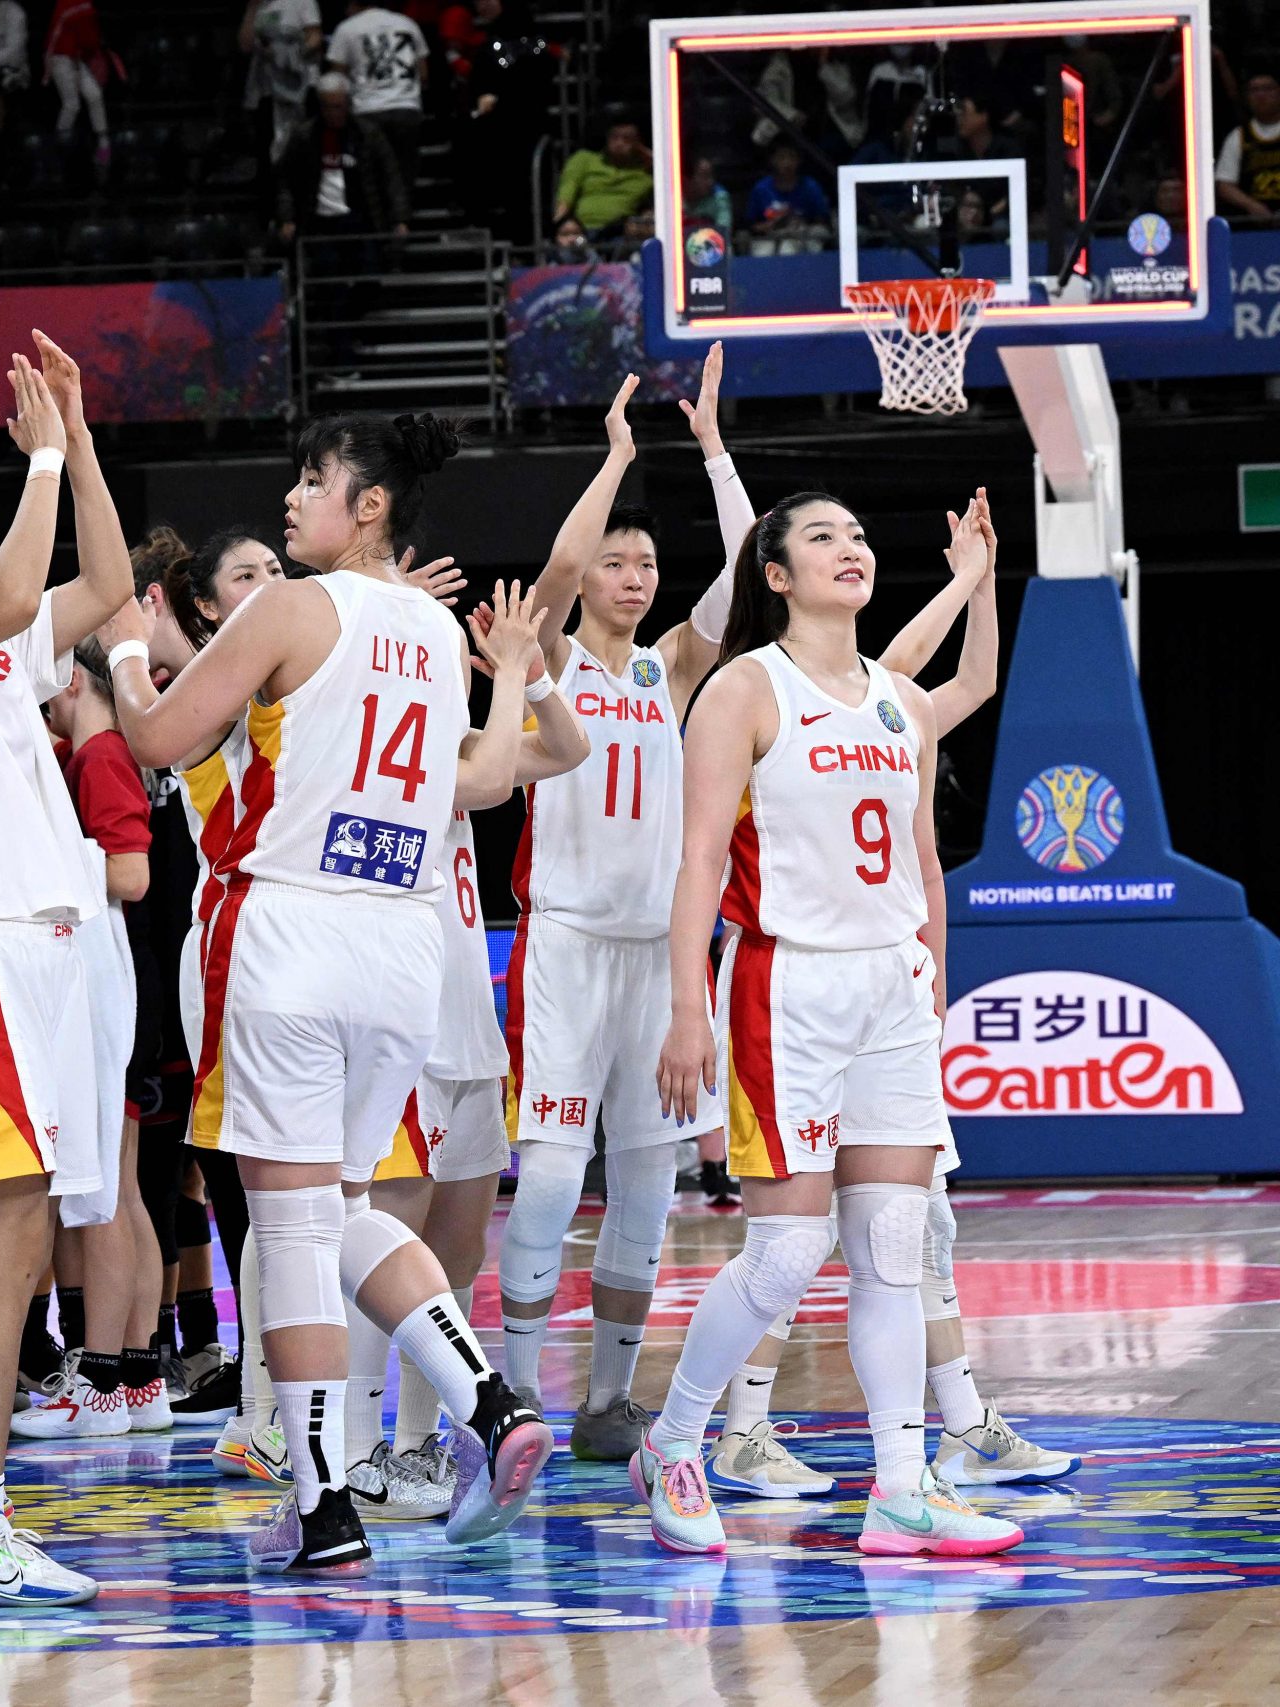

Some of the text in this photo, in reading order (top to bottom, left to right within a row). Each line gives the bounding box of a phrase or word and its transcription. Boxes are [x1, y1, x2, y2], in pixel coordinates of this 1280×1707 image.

[689, 276, 723, 295] FIBA
[575, 692, 665, 724] CHINA
[350, 693, 428, 803] 14
[808, 744, 914, 775] CHINA
[604, 742, 642, 820] 11
[369, 828, 423, 870] 秀域
[852, 798, 892, 885] 9
[324, 856, 415, 886] 智能健康
[453, 847, 476, 929] 6
[969, 882, 1175, 905] NOTHING BEATS LIKE IT
[971, 994, 1148, 1042] 百岁山
[532, 1093, 588, 1128] 中国
